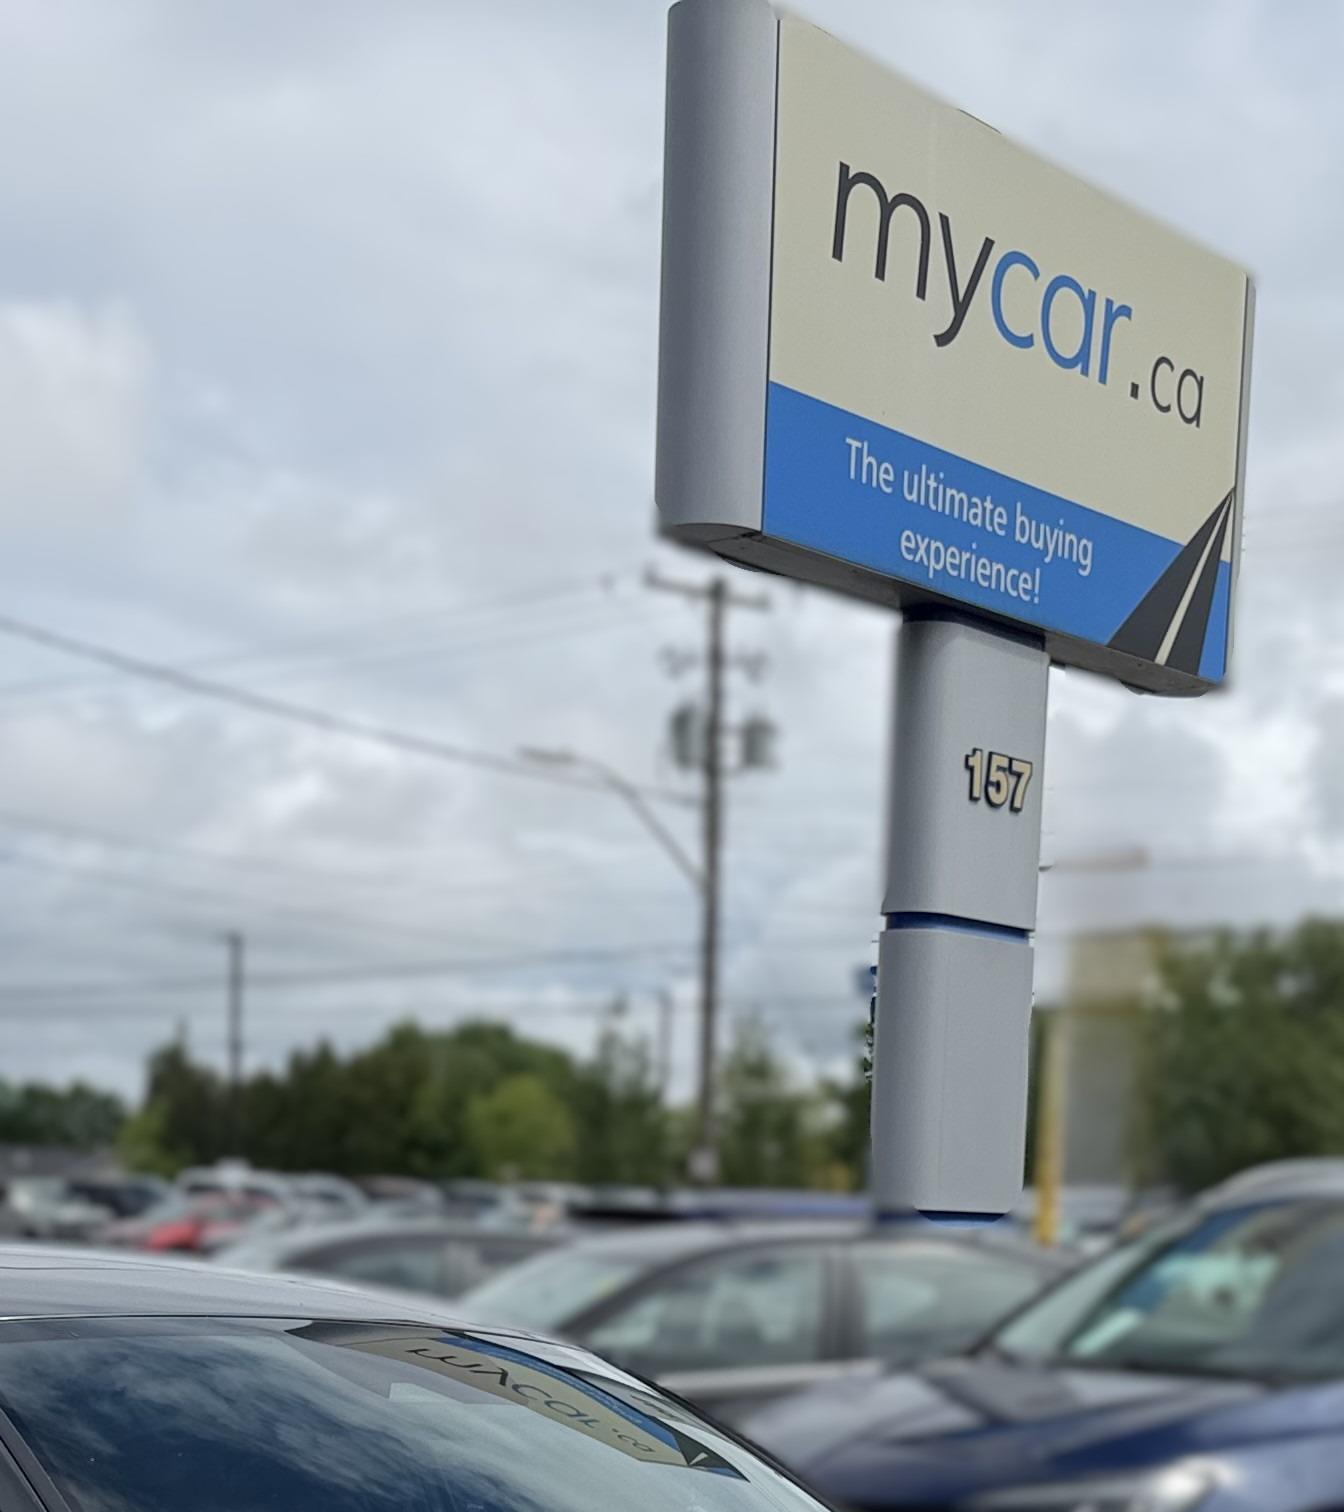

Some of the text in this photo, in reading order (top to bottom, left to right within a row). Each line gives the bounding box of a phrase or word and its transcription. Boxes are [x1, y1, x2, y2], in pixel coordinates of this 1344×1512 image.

[832, 161, 1205, 429] mycar.ca
[845, 437, 1094, 577] The ultimate buying
[900, 529, 1041, 605] experience!
[964, 747, 1033, 813] 157
